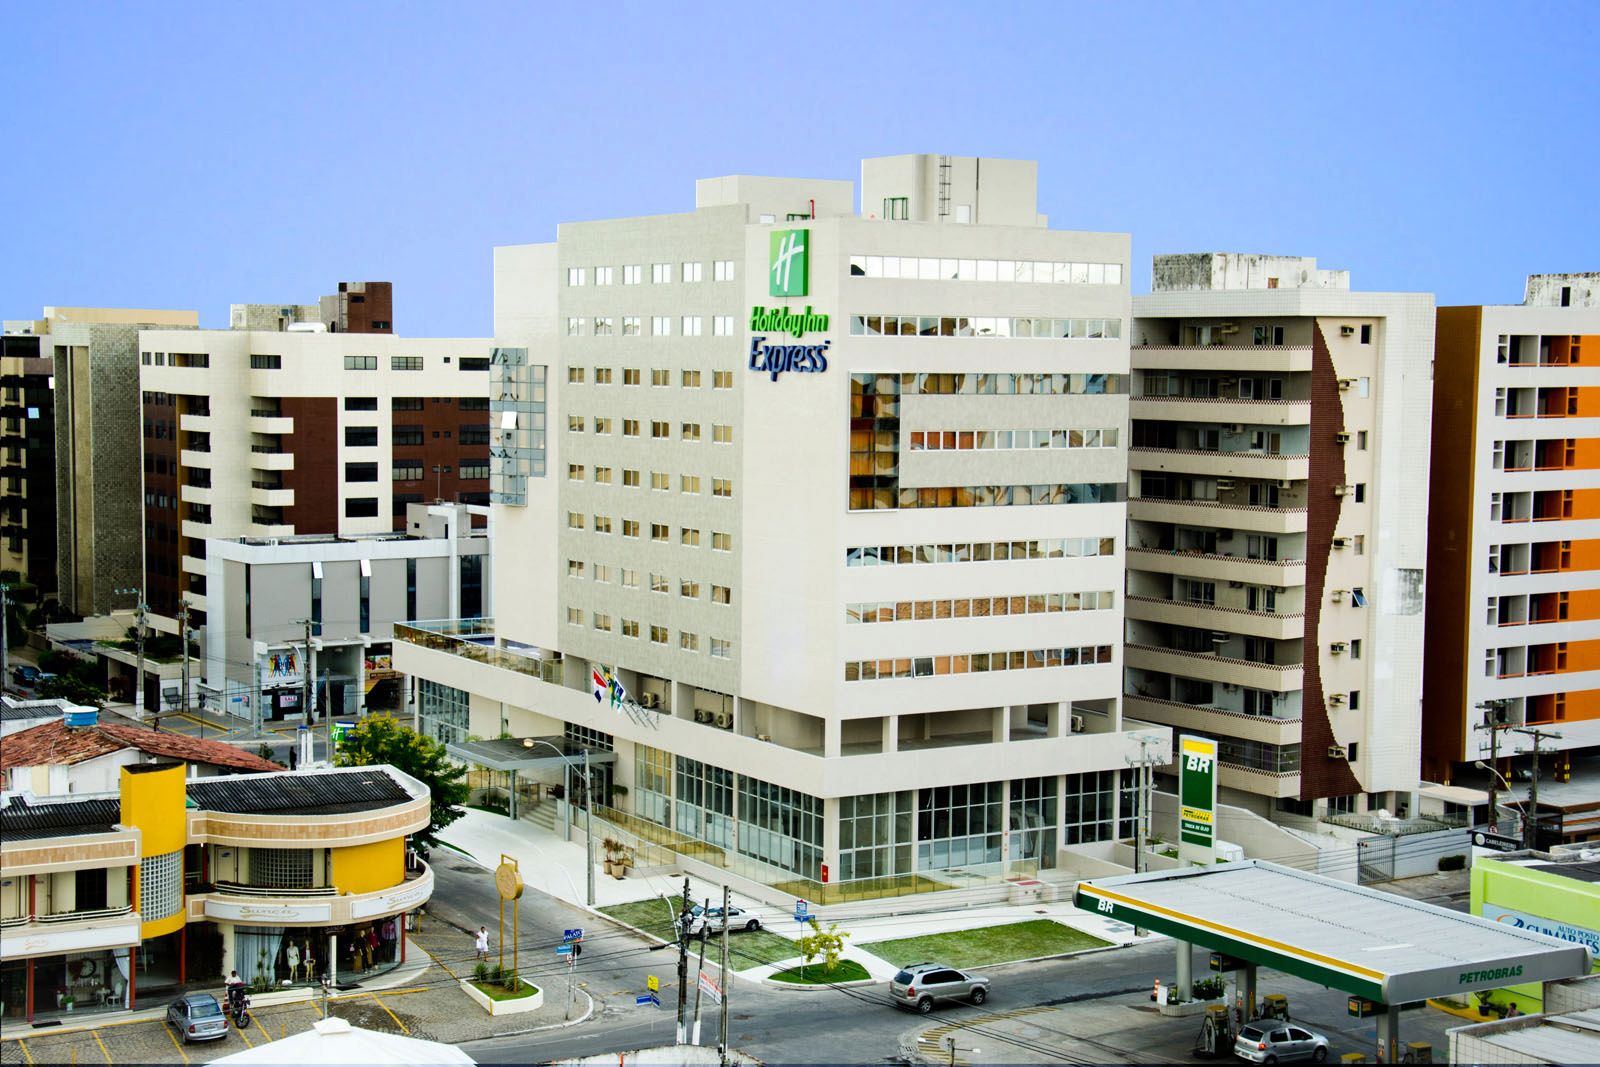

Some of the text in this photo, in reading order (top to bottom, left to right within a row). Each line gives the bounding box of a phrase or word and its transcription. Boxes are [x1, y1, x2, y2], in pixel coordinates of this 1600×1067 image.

[750, 306, 829, 338] Holiday Inn
[749, 337, 829, 382] Express
[1186, 753, 1210, 774] BR
[1097, 898, 1114, 914] BR
[1557, 925, 1599, 941] AUTO POSTO
[1459, 965, 1523, 984] PETROBRAS
